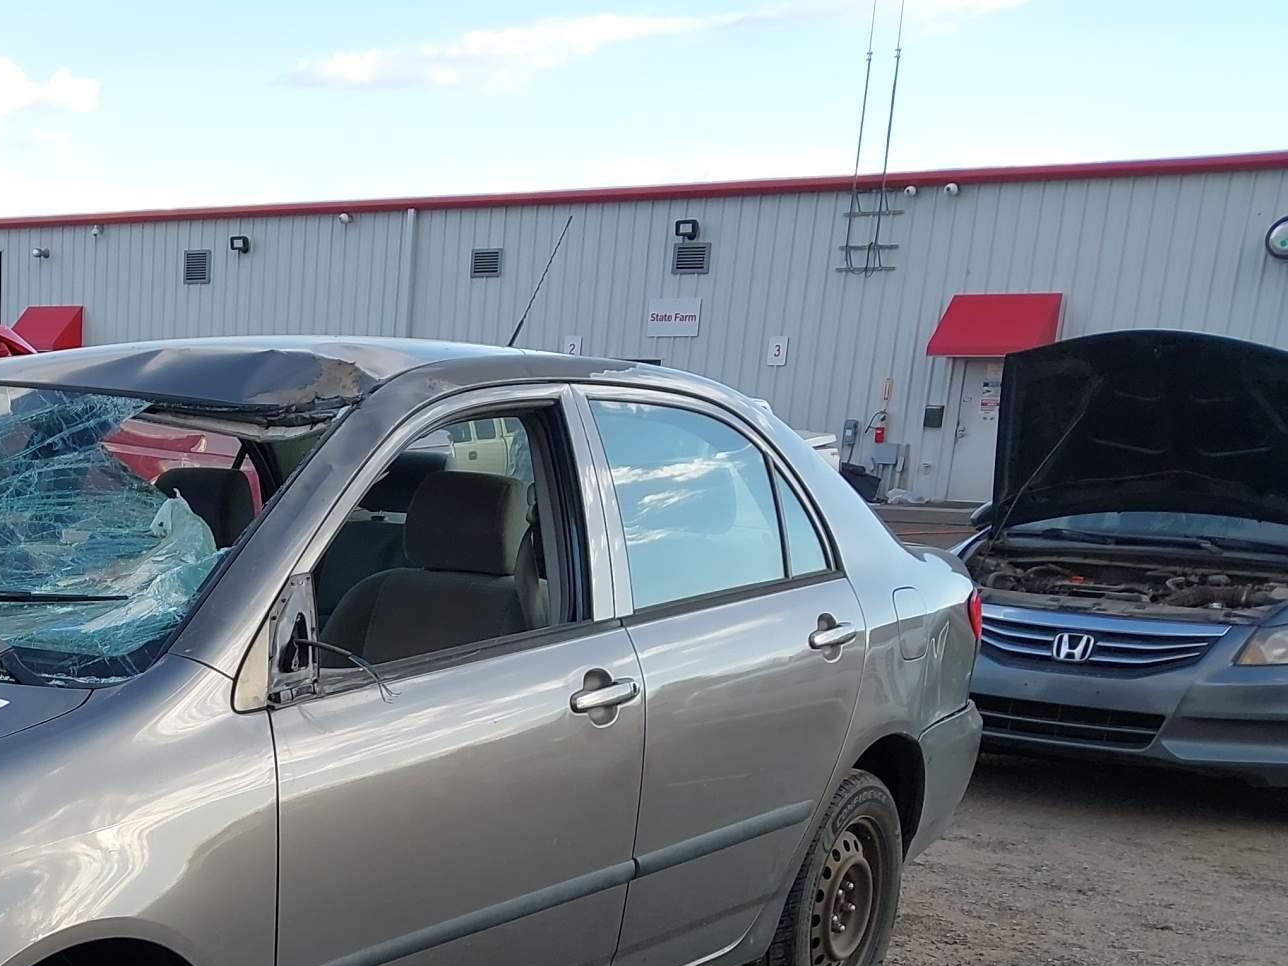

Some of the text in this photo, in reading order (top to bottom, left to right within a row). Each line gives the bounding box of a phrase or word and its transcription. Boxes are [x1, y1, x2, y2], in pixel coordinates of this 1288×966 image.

[650, 312, 697, 322] State Farm
[569, 343, 576, 356] 2
[774, 345, 781, 358] 3
